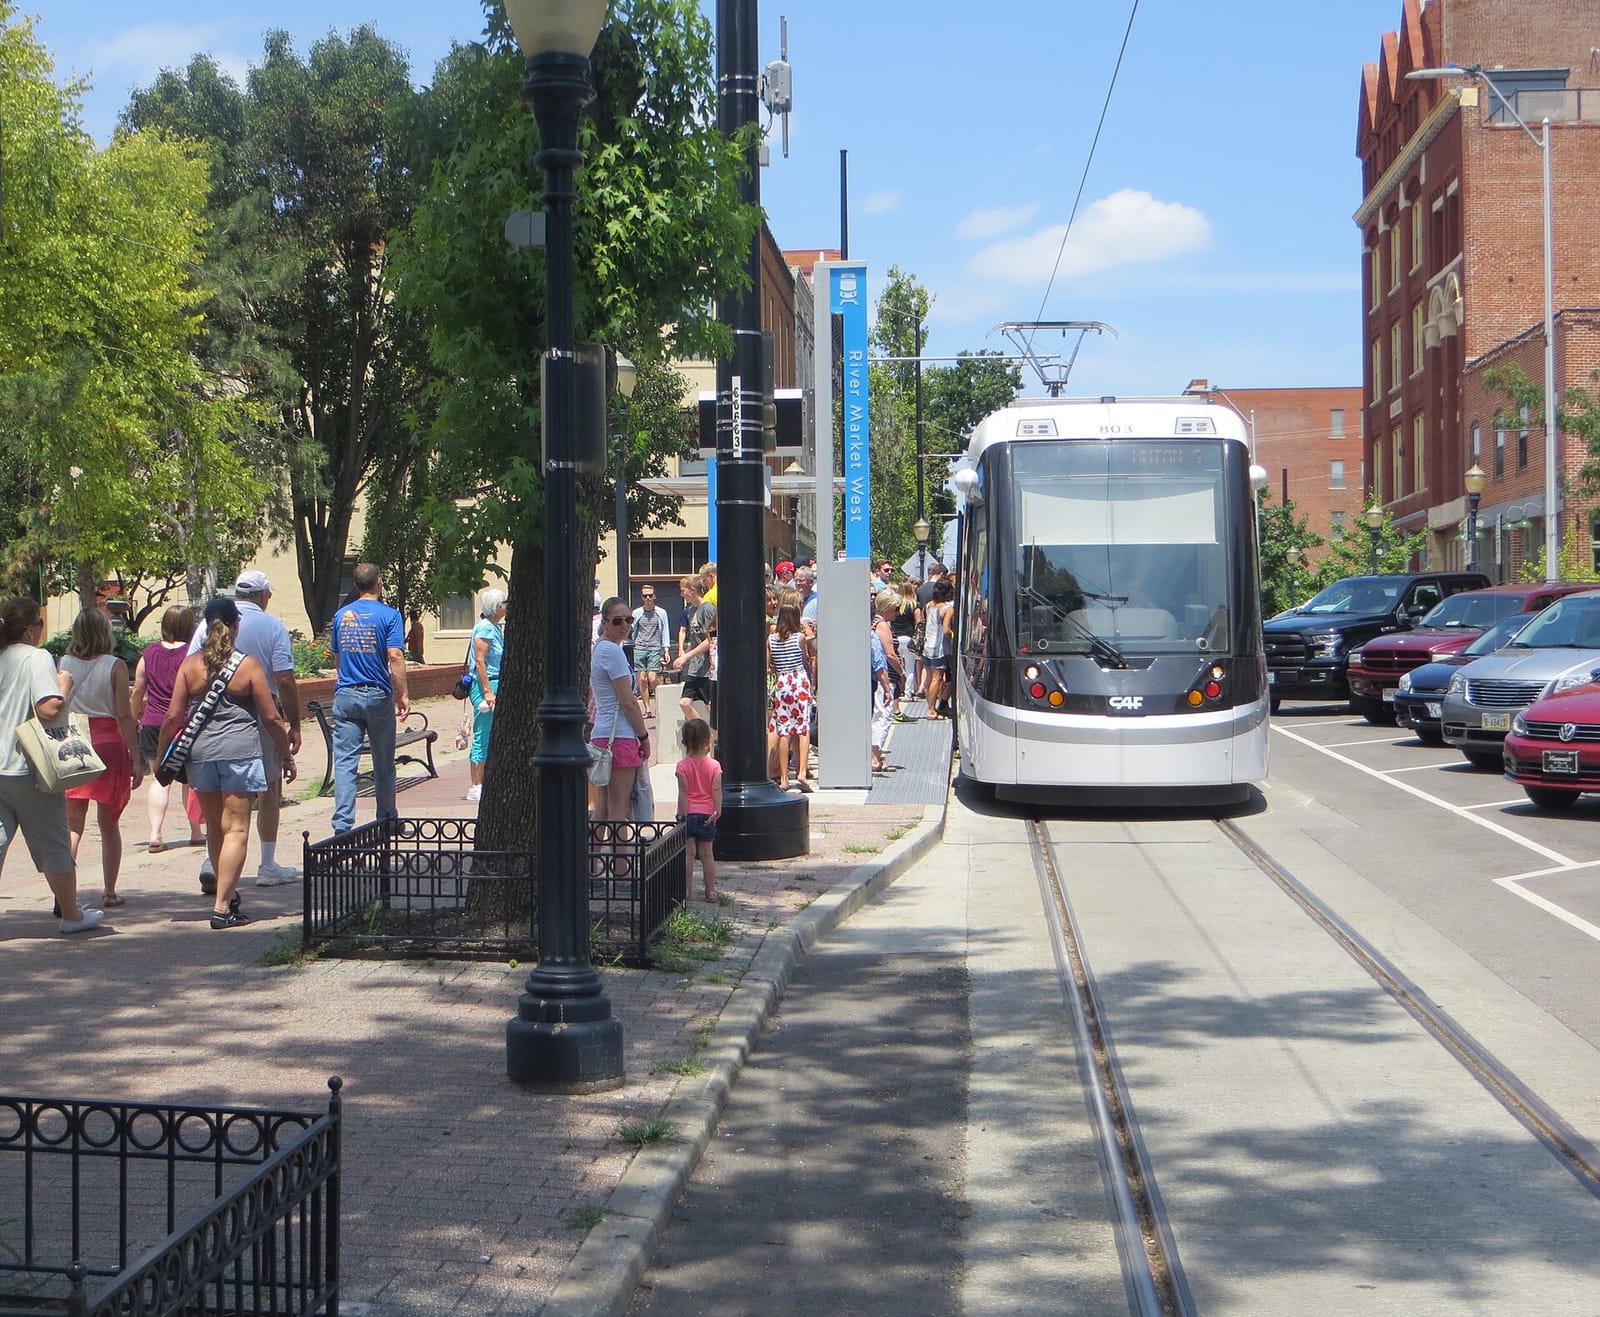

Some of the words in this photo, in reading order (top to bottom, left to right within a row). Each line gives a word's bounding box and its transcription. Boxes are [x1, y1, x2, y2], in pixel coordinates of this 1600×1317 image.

[849, 351, 863, 397] River
[850, 404, 864, 469] Market
[1100, 424, 1133, 435] 803
[850, 477, 865, 522] West
[184, 679, 227, 735] COLOR
[1108, 696, 1144, 710] CAF
[165, 734, 194, 772] RUN
